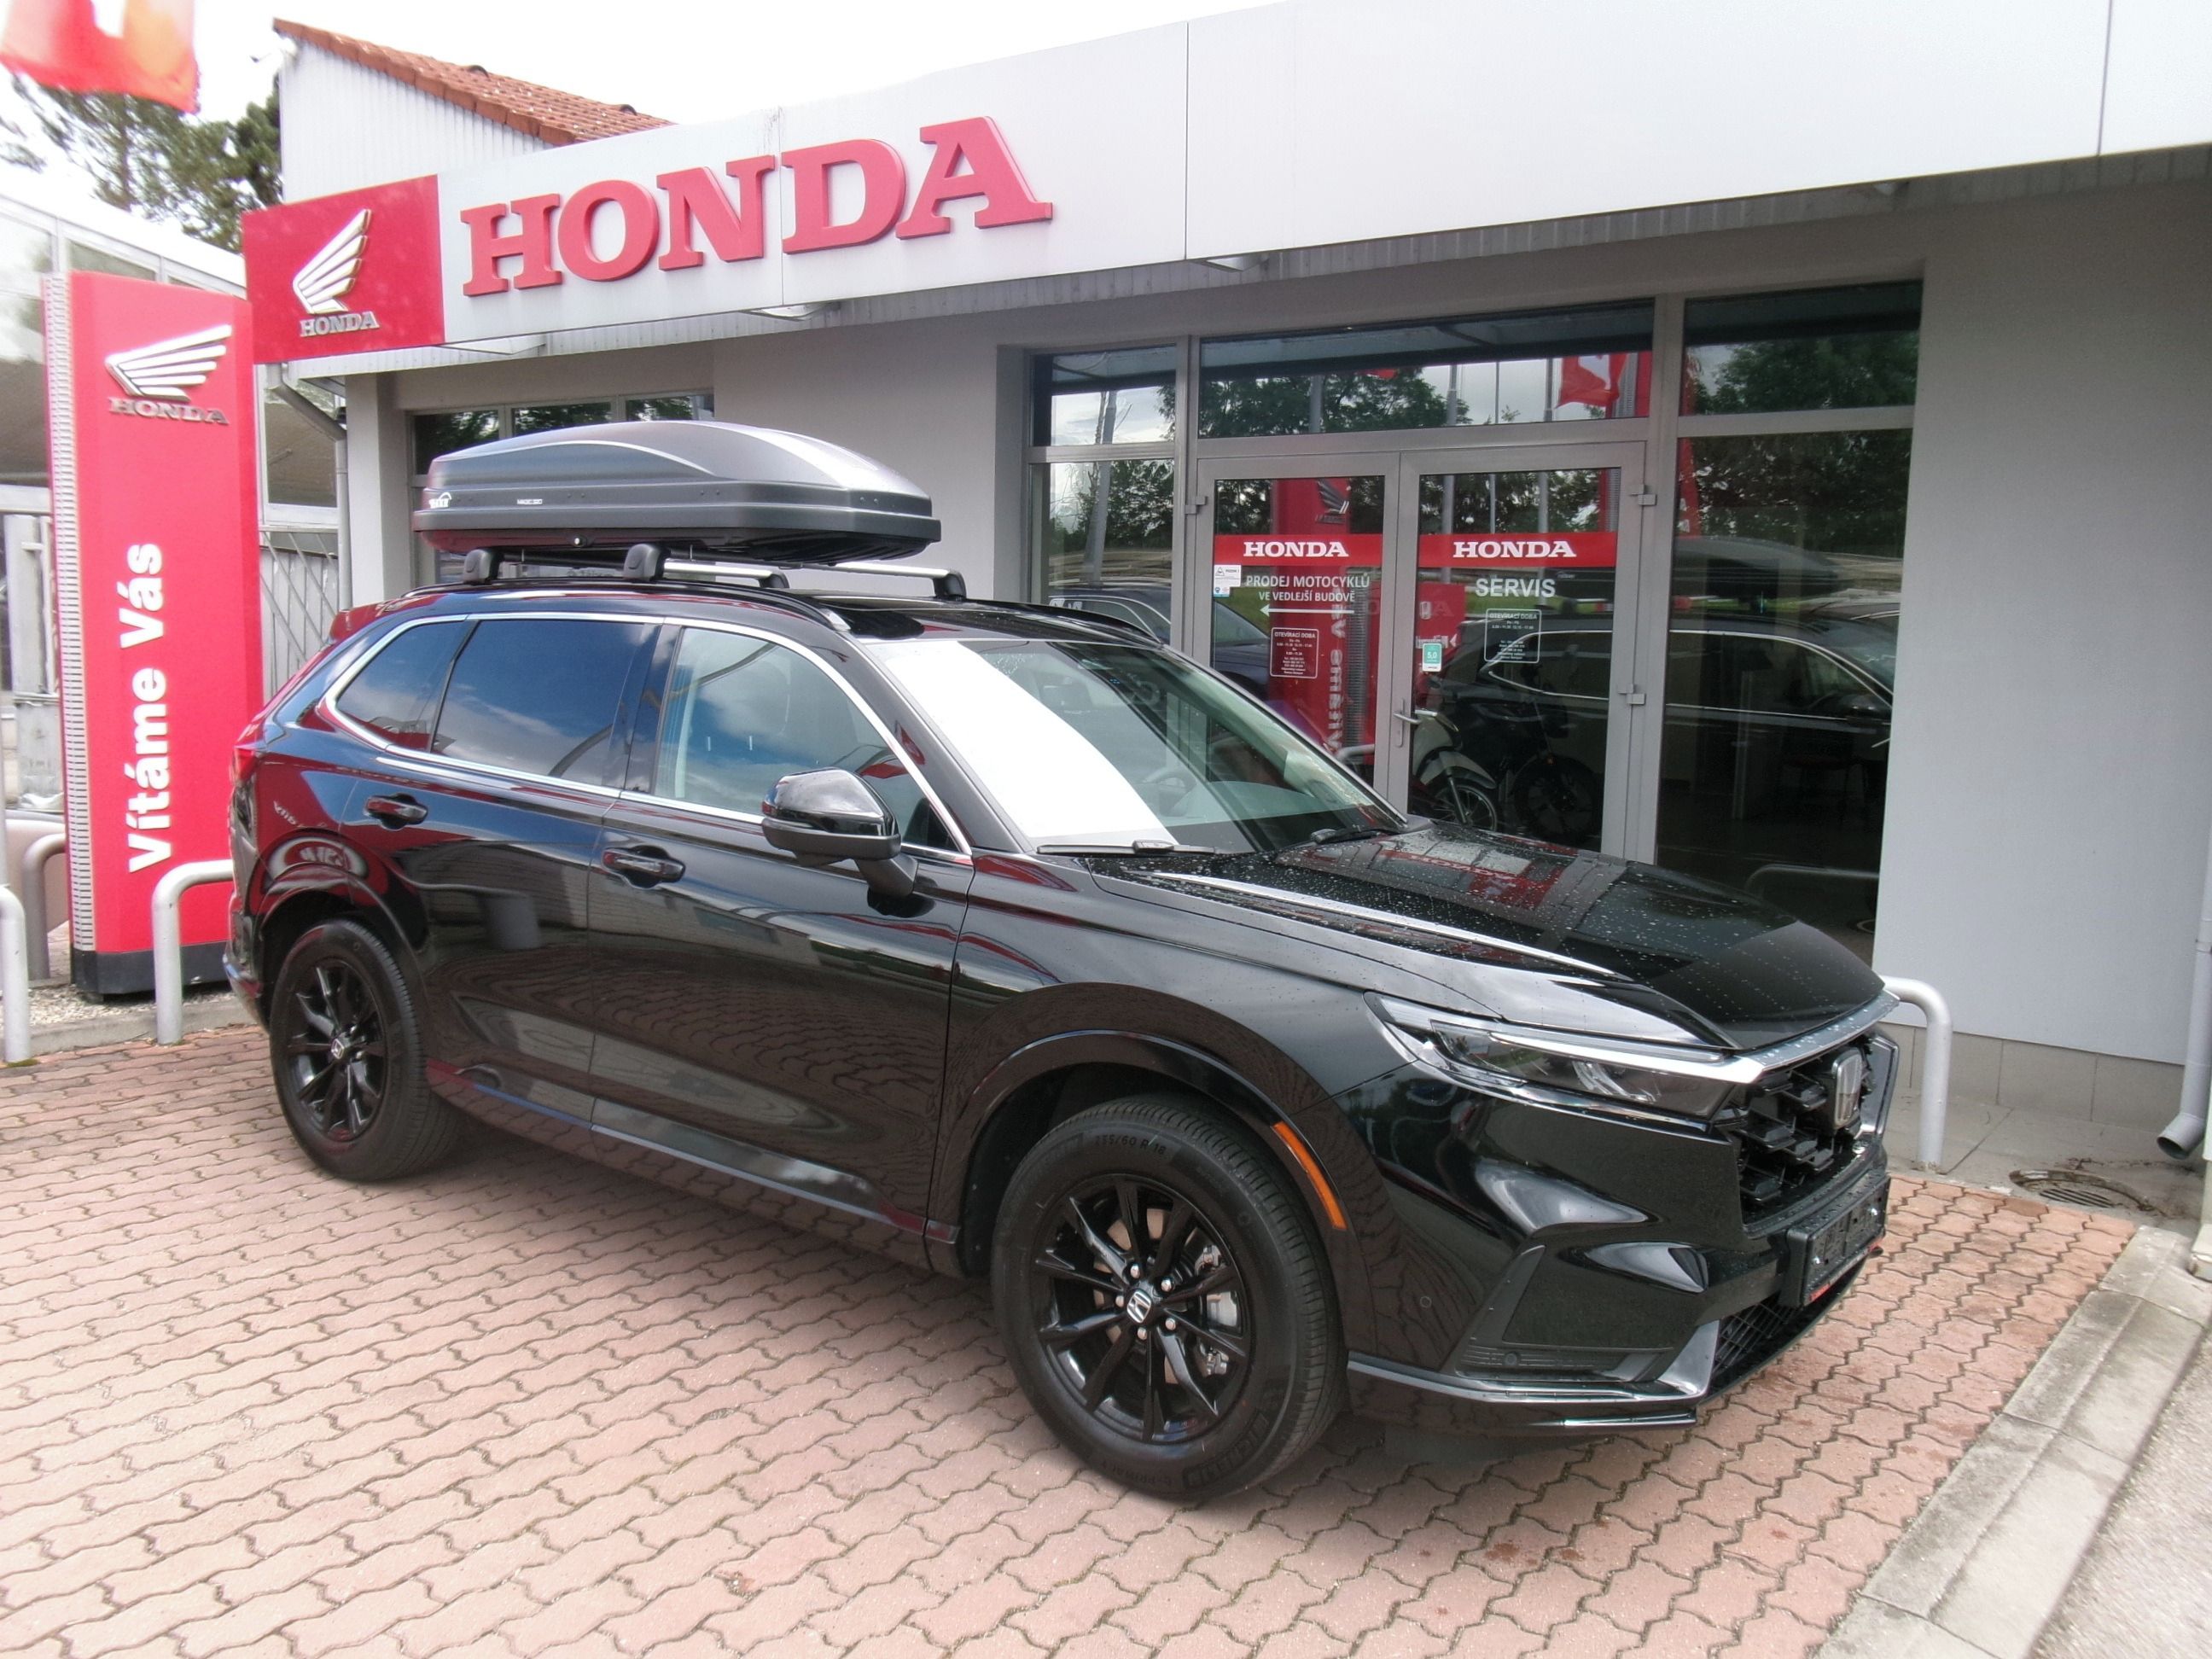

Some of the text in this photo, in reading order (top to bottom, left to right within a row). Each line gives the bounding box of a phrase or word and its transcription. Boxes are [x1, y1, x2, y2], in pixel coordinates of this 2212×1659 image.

[460, 115, 1053, 297] HONDA
[300, 311, 380, 338] HONDA
[108, 396, 230, 426] HONDA
[1243, 541, 1349, 557] HONDA
[1452, 540, 1577, 558] HONDA
[1246, 575, 1290, 588] PRODEJ
[1293, 572, 1371, 588] MOTOCYKLŮ
[1475, 578, 1556, 597] SERVIS
[1258, 590, 1356, 602] VE VEDLEJŠÍ BUDOVĚ
[116, 543, 172, 874] Vítáme Vás
